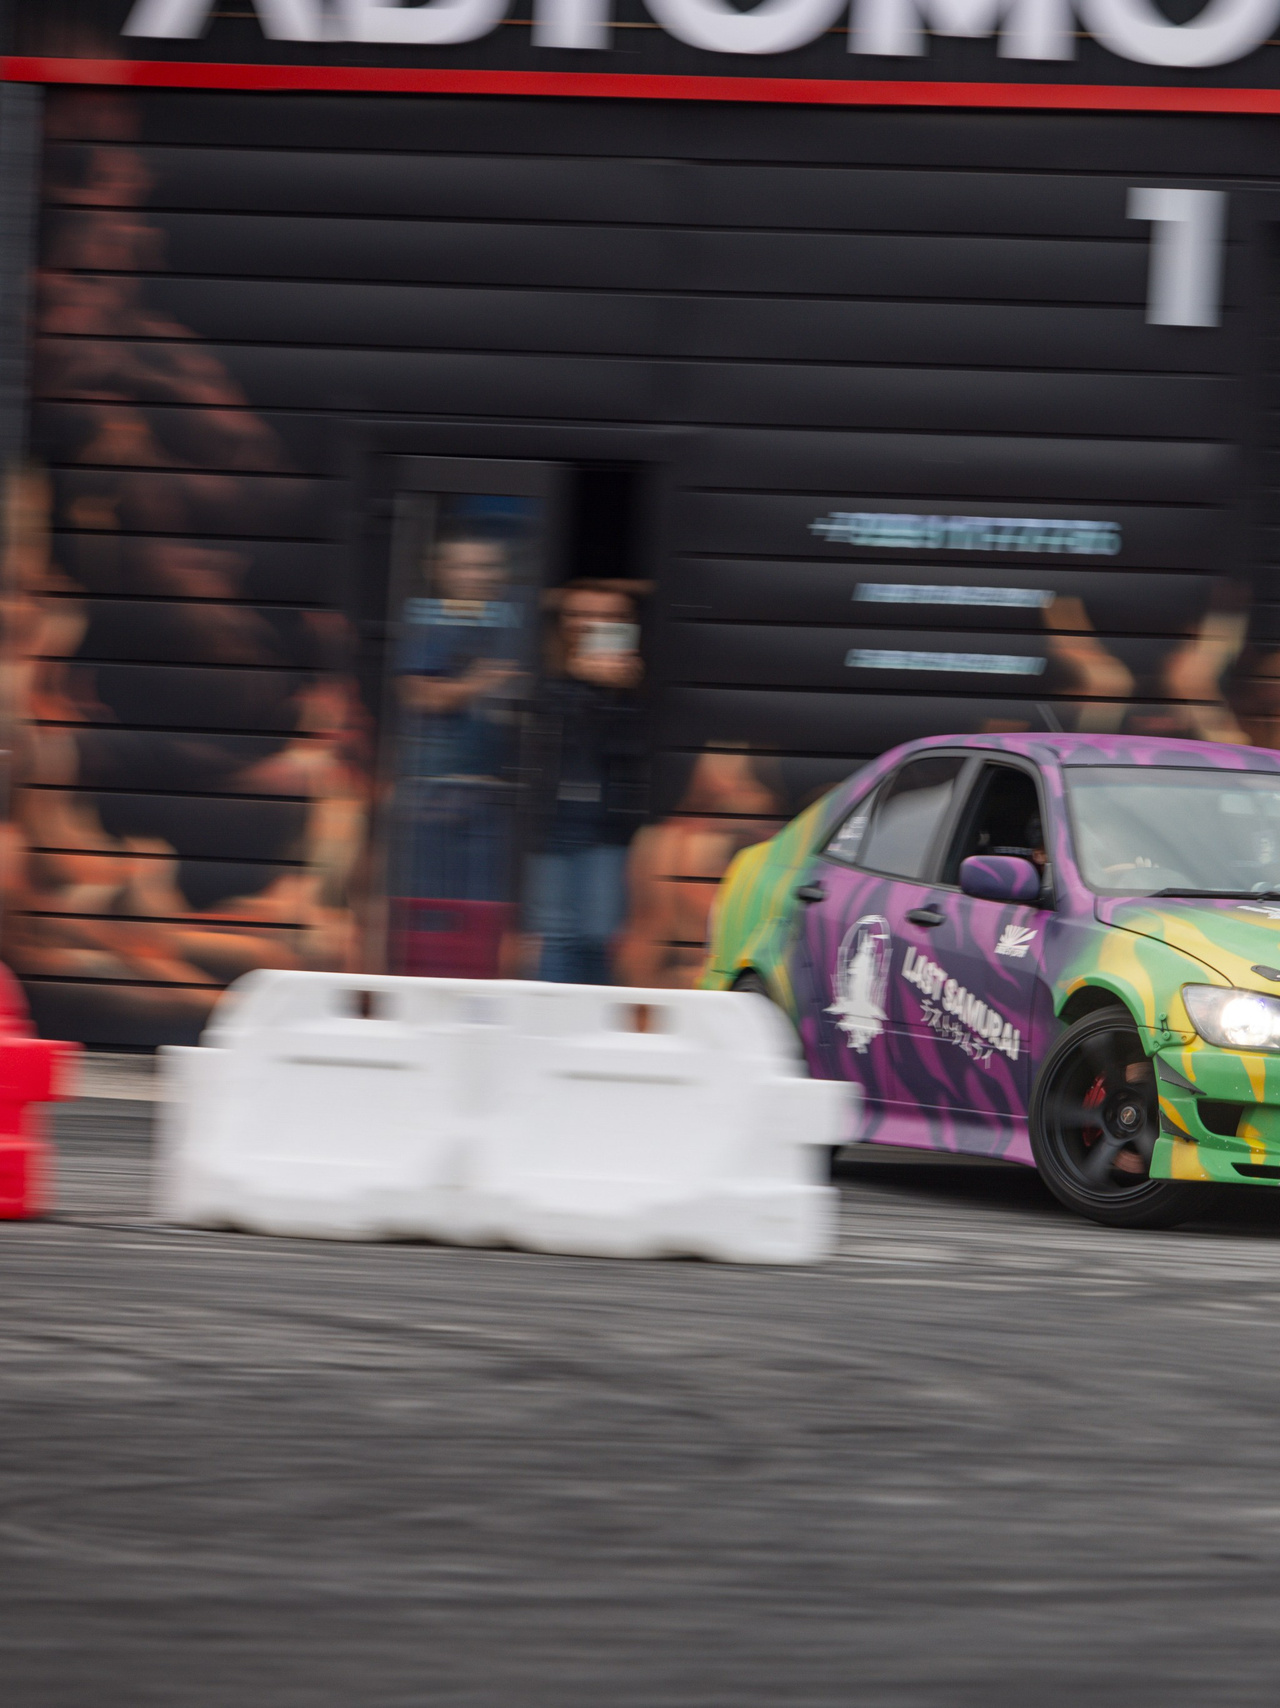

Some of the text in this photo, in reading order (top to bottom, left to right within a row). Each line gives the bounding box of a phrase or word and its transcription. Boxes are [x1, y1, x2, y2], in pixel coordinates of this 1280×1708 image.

[1127, 187, 1227, 327] 1
[902, 946, 1020, 1061] LAST SAMURAI
